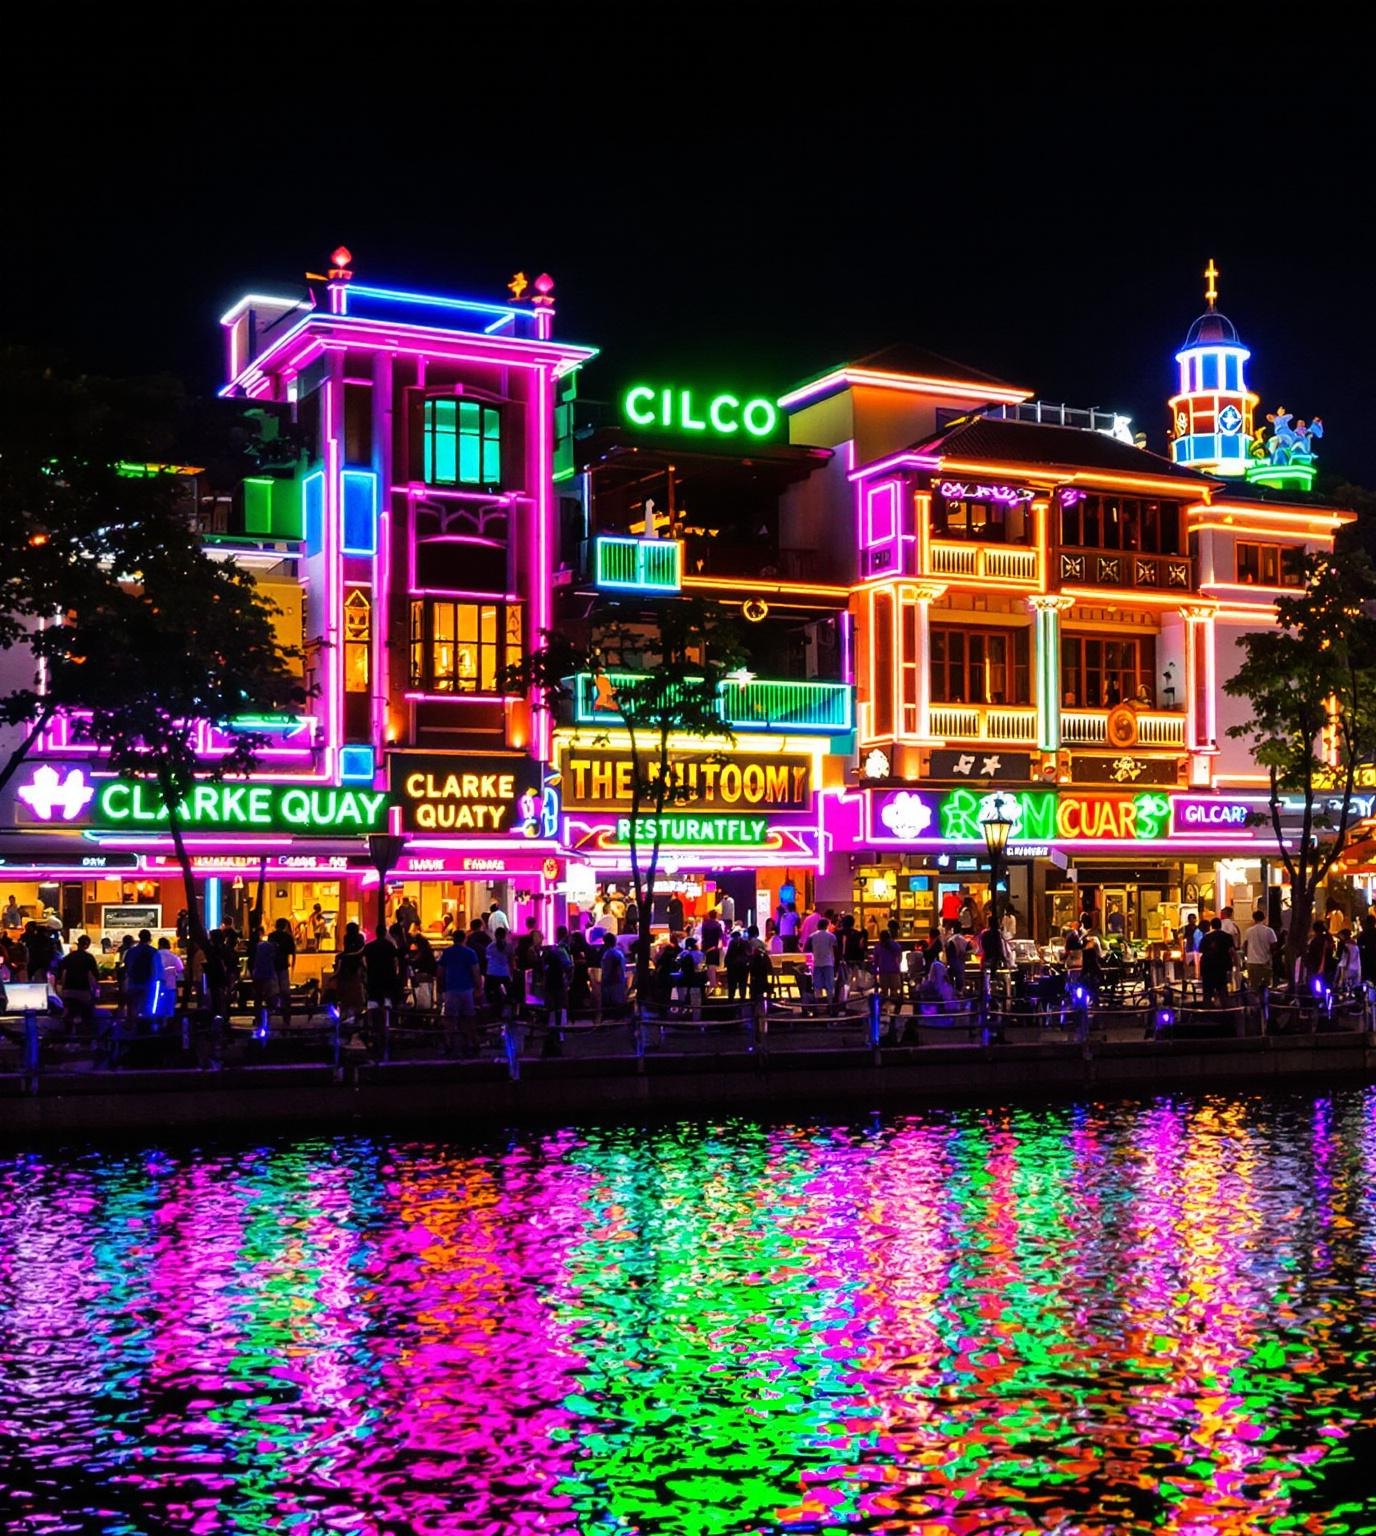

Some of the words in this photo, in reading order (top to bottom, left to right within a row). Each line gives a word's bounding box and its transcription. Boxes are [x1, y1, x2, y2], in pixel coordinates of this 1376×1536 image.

[626, 387, 776, 436] CILCO
[406, 774, 515, 798] CLARKE
[570, 760, 634, 799] THE
[281, 789, 385, 825] QUAY
[416, 803, 506, 828] QUATY
